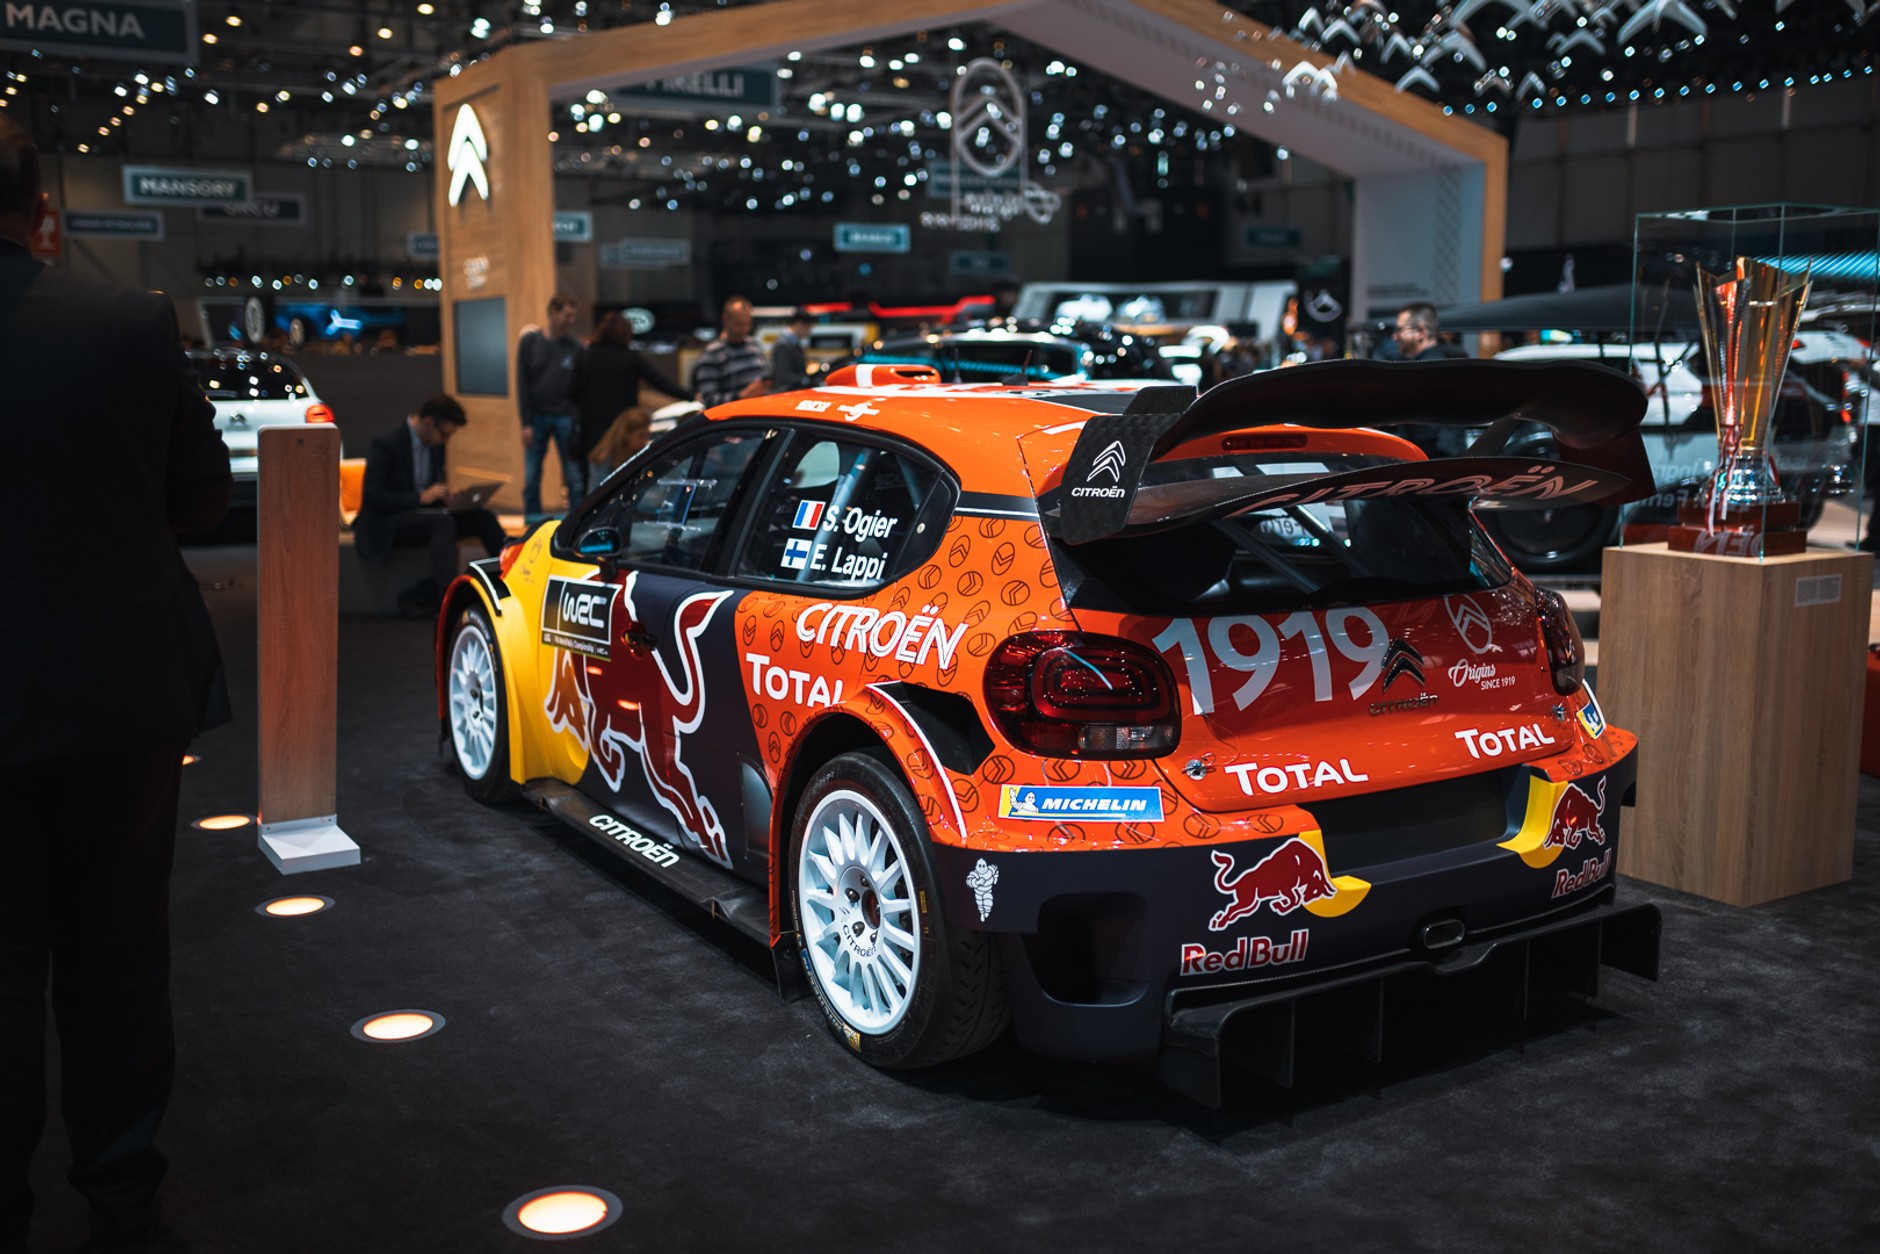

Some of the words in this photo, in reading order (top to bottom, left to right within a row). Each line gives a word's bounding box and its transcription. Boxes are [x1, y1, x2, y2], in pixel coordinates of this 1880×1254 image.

[5, 2, 145, 39] MAGNA
[138, 176, 239, 198] MANSORY
[1070, 485, 1126, 499] CITROËN
[822, 505, 839, 532] S.
[843, 507, 898, 542] Ogier
[809, 544, 828, 571] E.
[831, 546, 888, 583] Lappi
[562, 592, 607, 629] WRC
[796, 603, 969, 670] CITROËN
[1152, 605, 1390, 716] 1919
[1447, 658, 1497, 688] Origins
[746, 652, 847, 708] TOTAL
[1480, 678, 1501, 691] SINCE
[1501, 675, 1516, 688] 1919
[1454, 722, 1555, 759] TOTAL
[1224, 758, 1369, 796] TOTAL
[1041, 797, 1148, 812] MICHELIN
[588, 814, 680, 868] CITROËN
[1551, 859, 1588, 899] Red
[1586, 848, 1612, 882] Bull
[842, 924, 877, 957] CITROËN
[1179, 937, 1248, 977] Red
[1248, 929, 1310, 969] Bull
